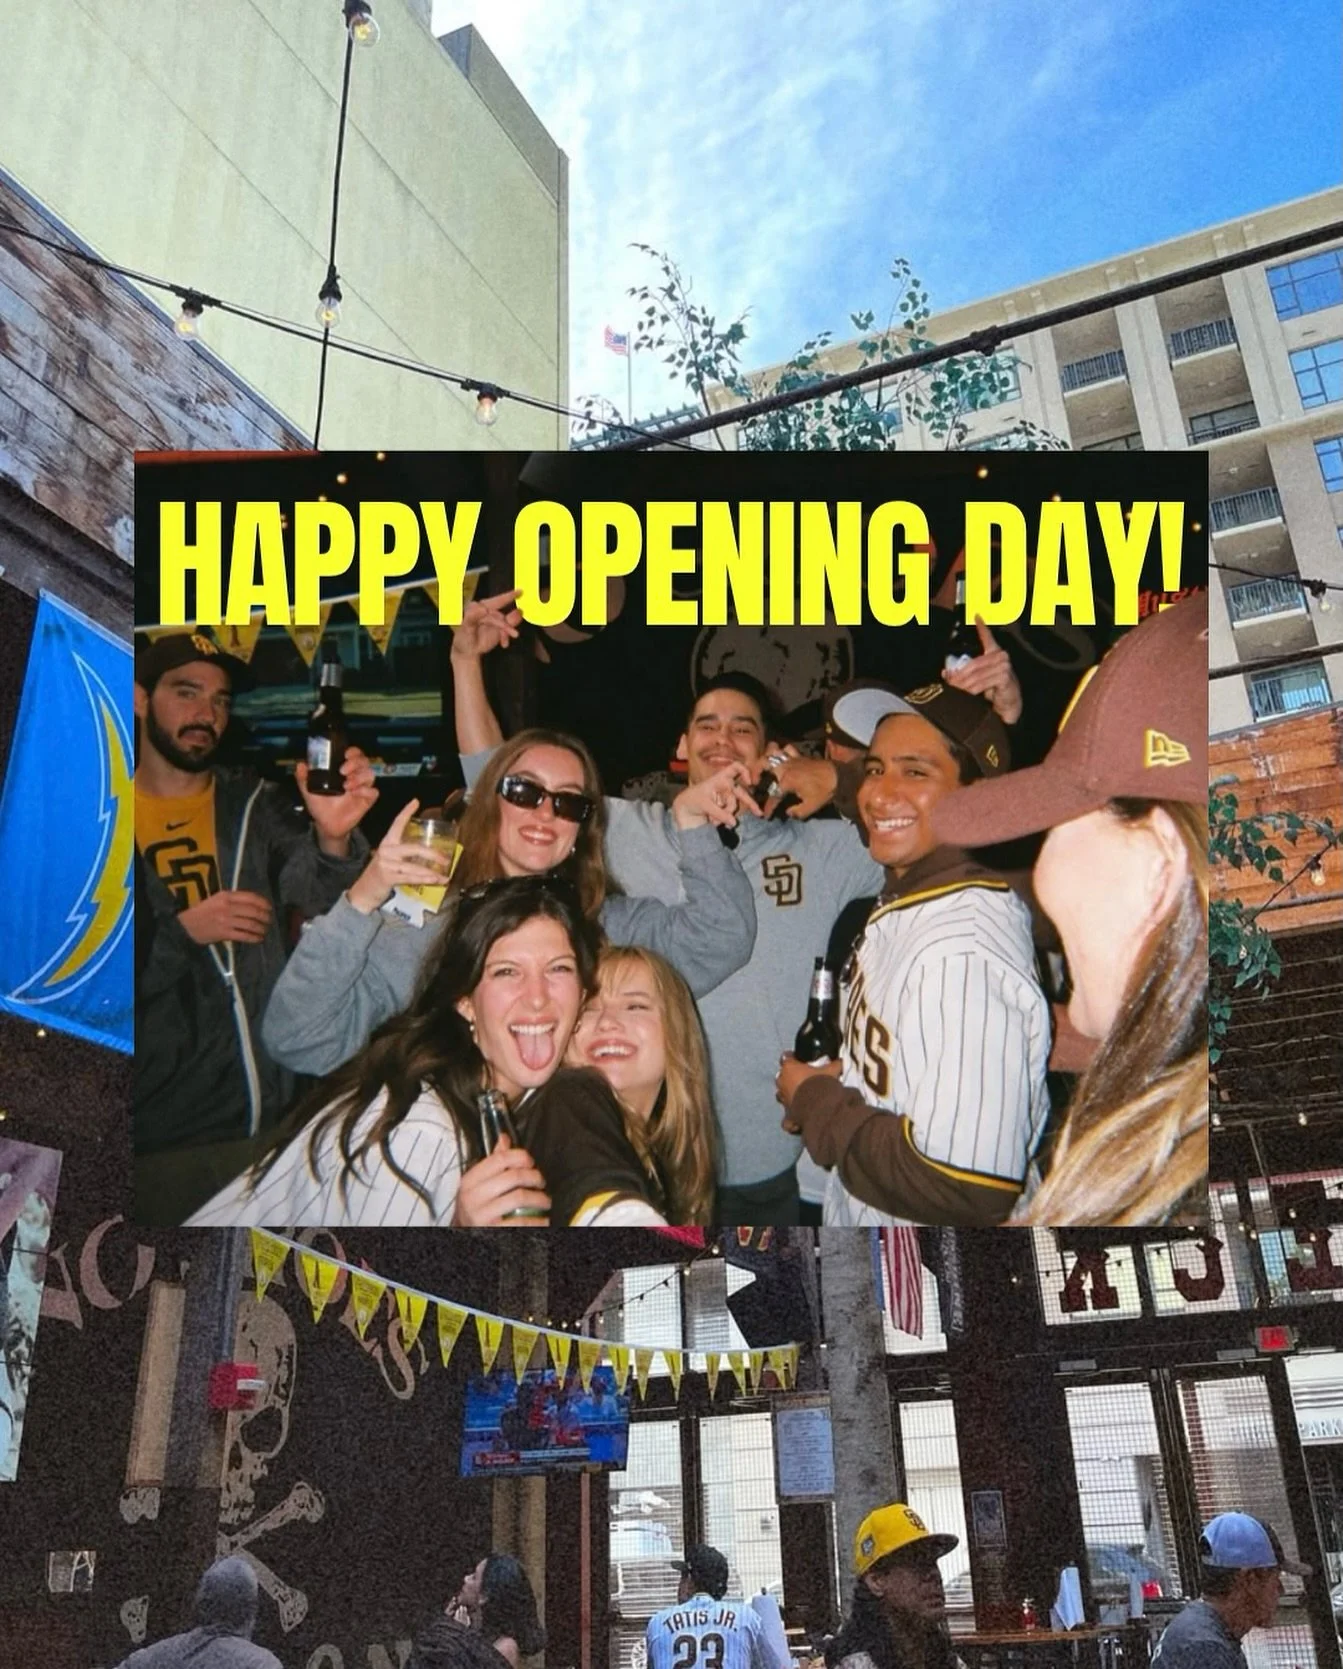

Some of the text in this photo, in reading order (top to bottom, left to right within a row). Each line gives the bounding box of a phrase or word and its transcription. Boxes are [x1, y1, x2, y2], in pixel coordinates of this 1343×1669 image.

[761, 854, 803, 907] SD
[663, 1609, 738, 1634] TATIS JR.
[672, 1631, 726, 1669] 23
